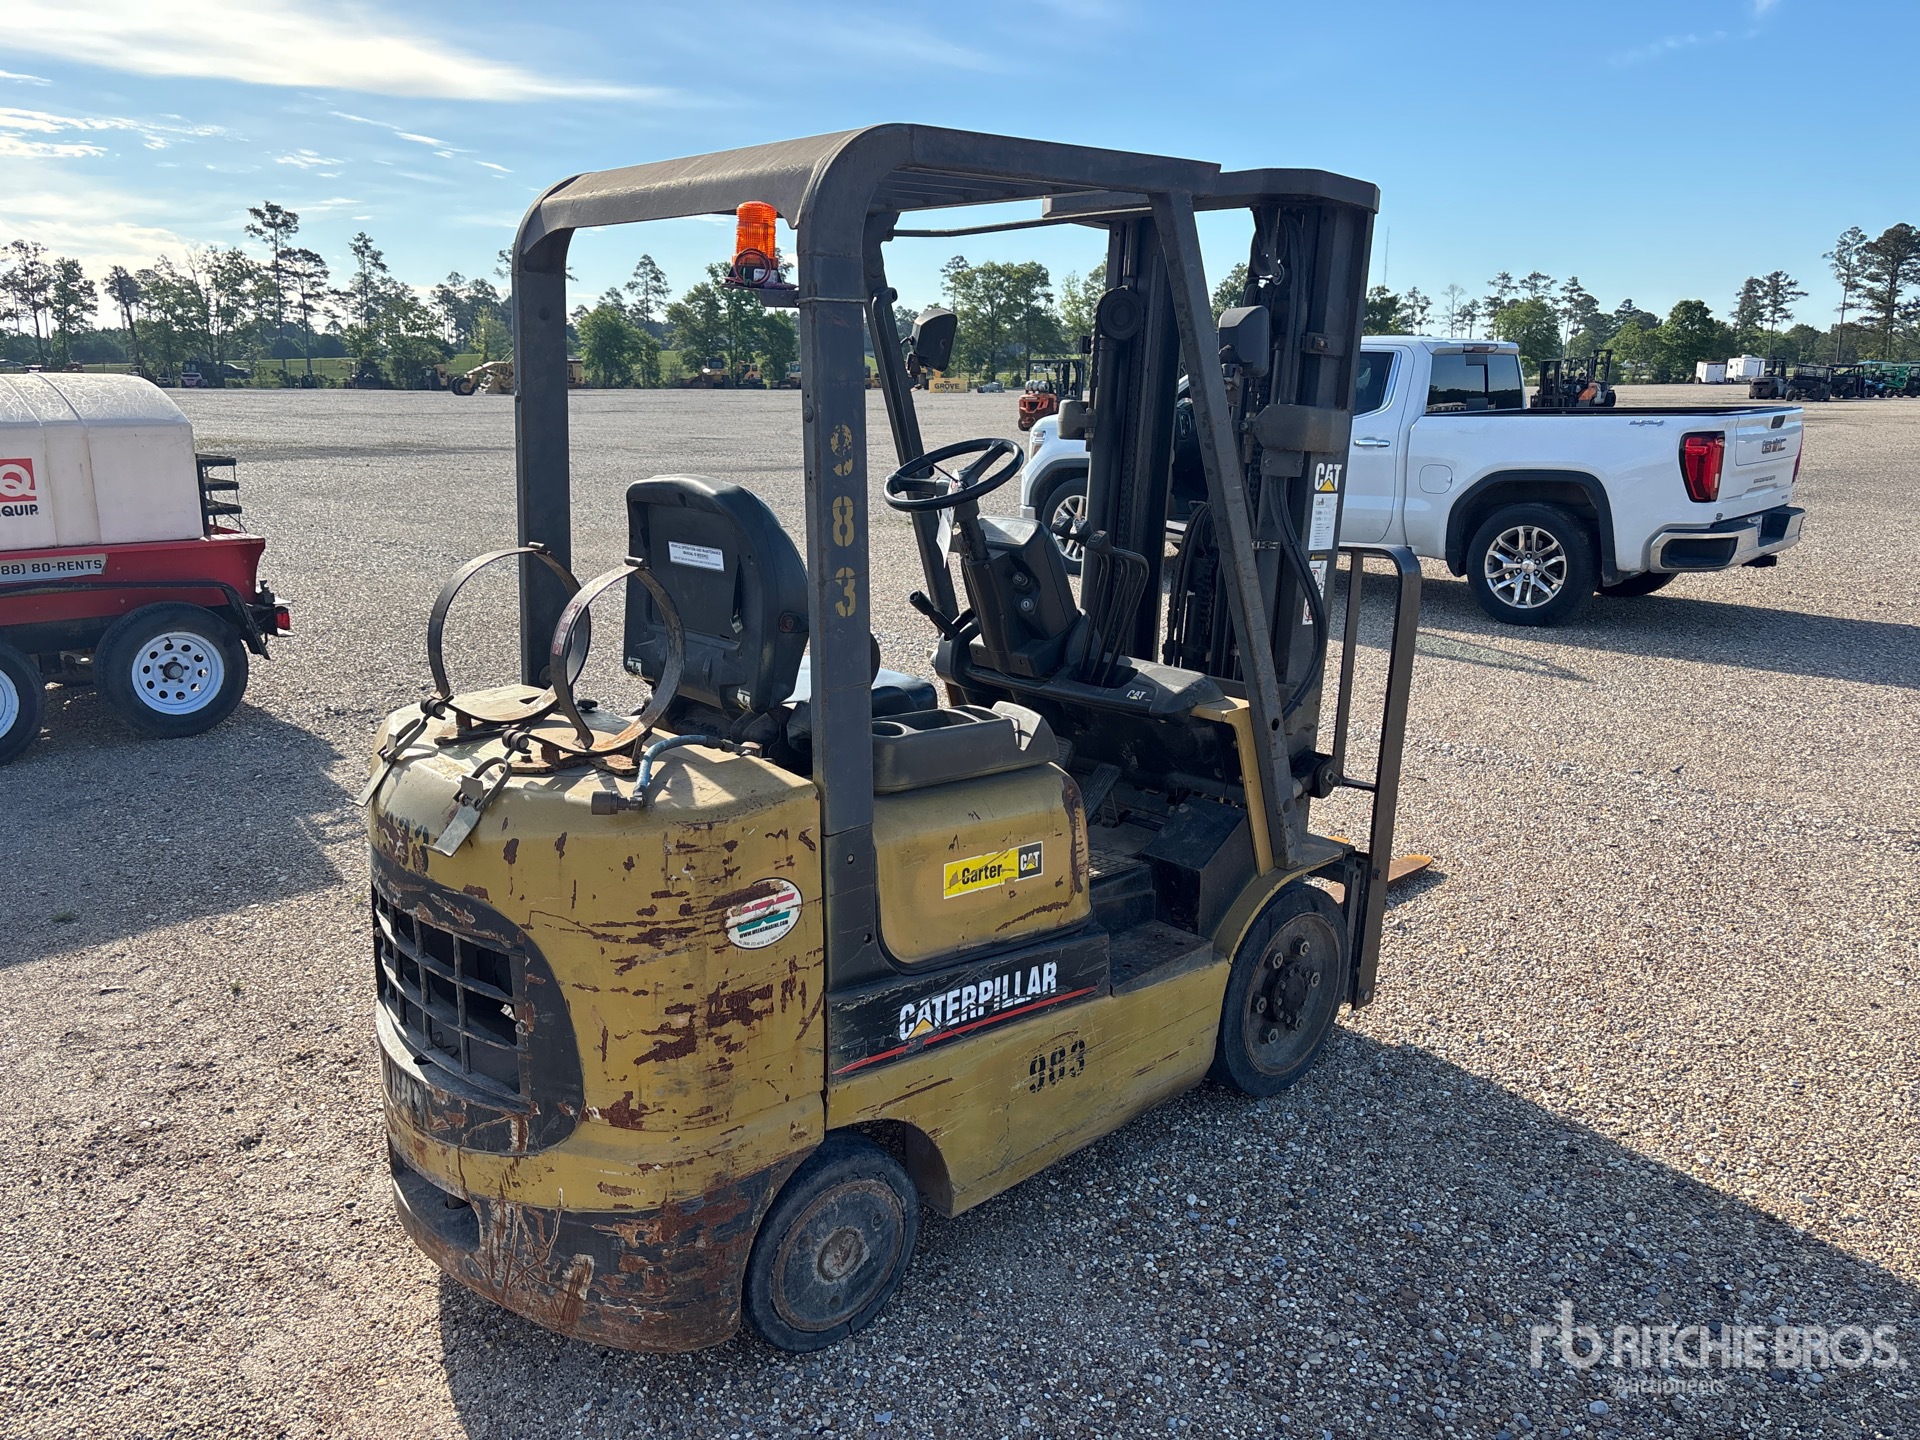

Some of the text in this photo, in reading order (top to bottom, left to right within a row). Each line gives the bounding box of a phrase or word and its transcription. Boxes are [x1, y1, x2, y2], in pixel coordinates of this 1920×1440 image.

[934, 382, 960, 390] GROVE
[1314, 462, 1342, 491] CAT
[0, 504, 38, 517] QUIP
[31, 559, 102, 573] 80-RENTS
[1126, 689, 1147, 700] CAT
[961, 851, 1040, 885] Carter CAT
[899, 961, 1058, 1041] CATERPILLAR
